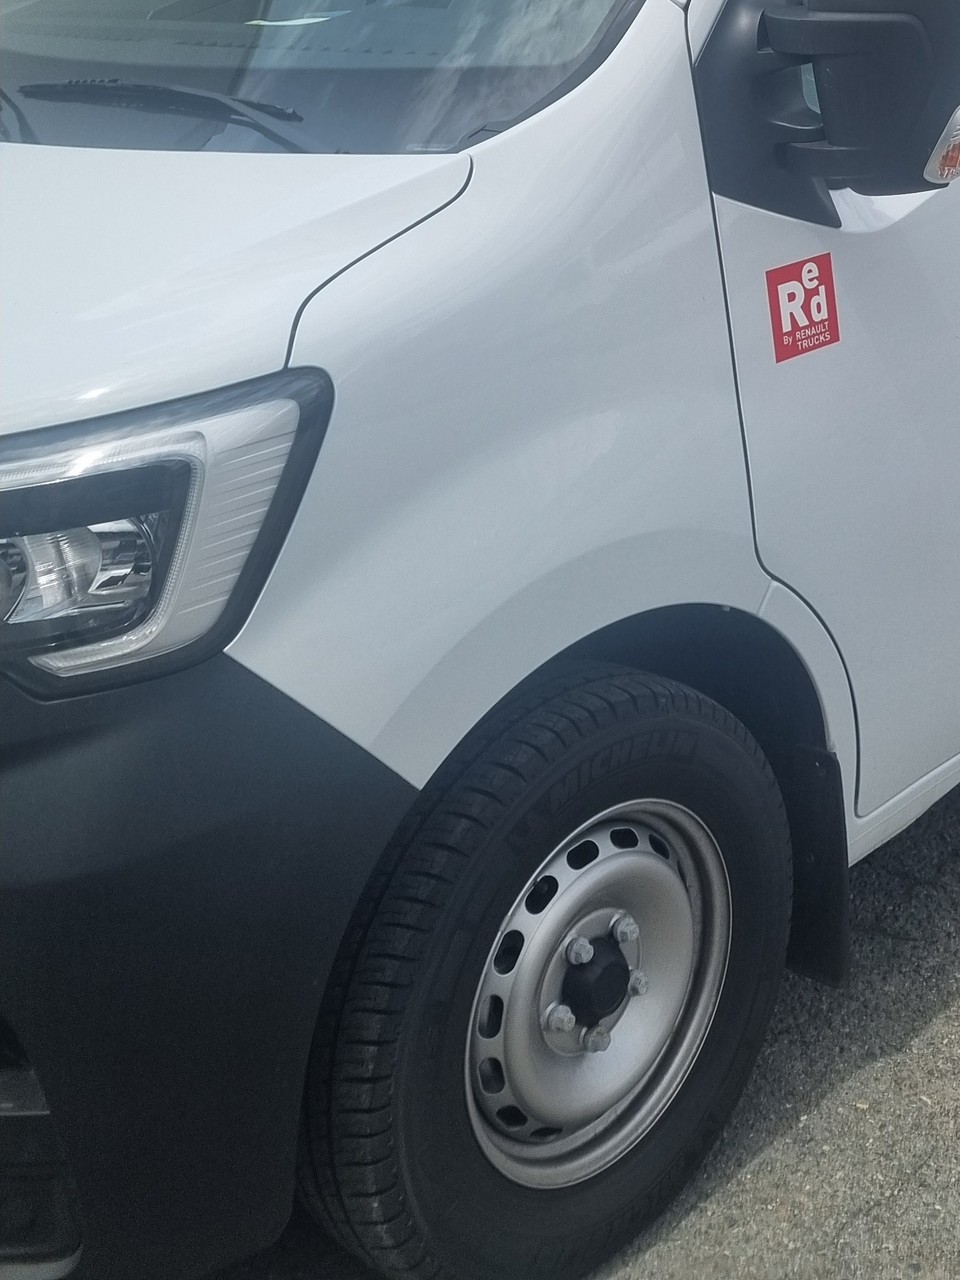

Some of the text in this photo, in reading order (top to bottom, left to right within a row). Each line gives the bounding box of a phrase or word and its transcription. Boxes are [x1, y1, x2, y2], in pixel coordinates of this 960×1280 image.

[783, 321, 829, 346] By RENAULT
[797, 332, 831, 350] TRUCKS
